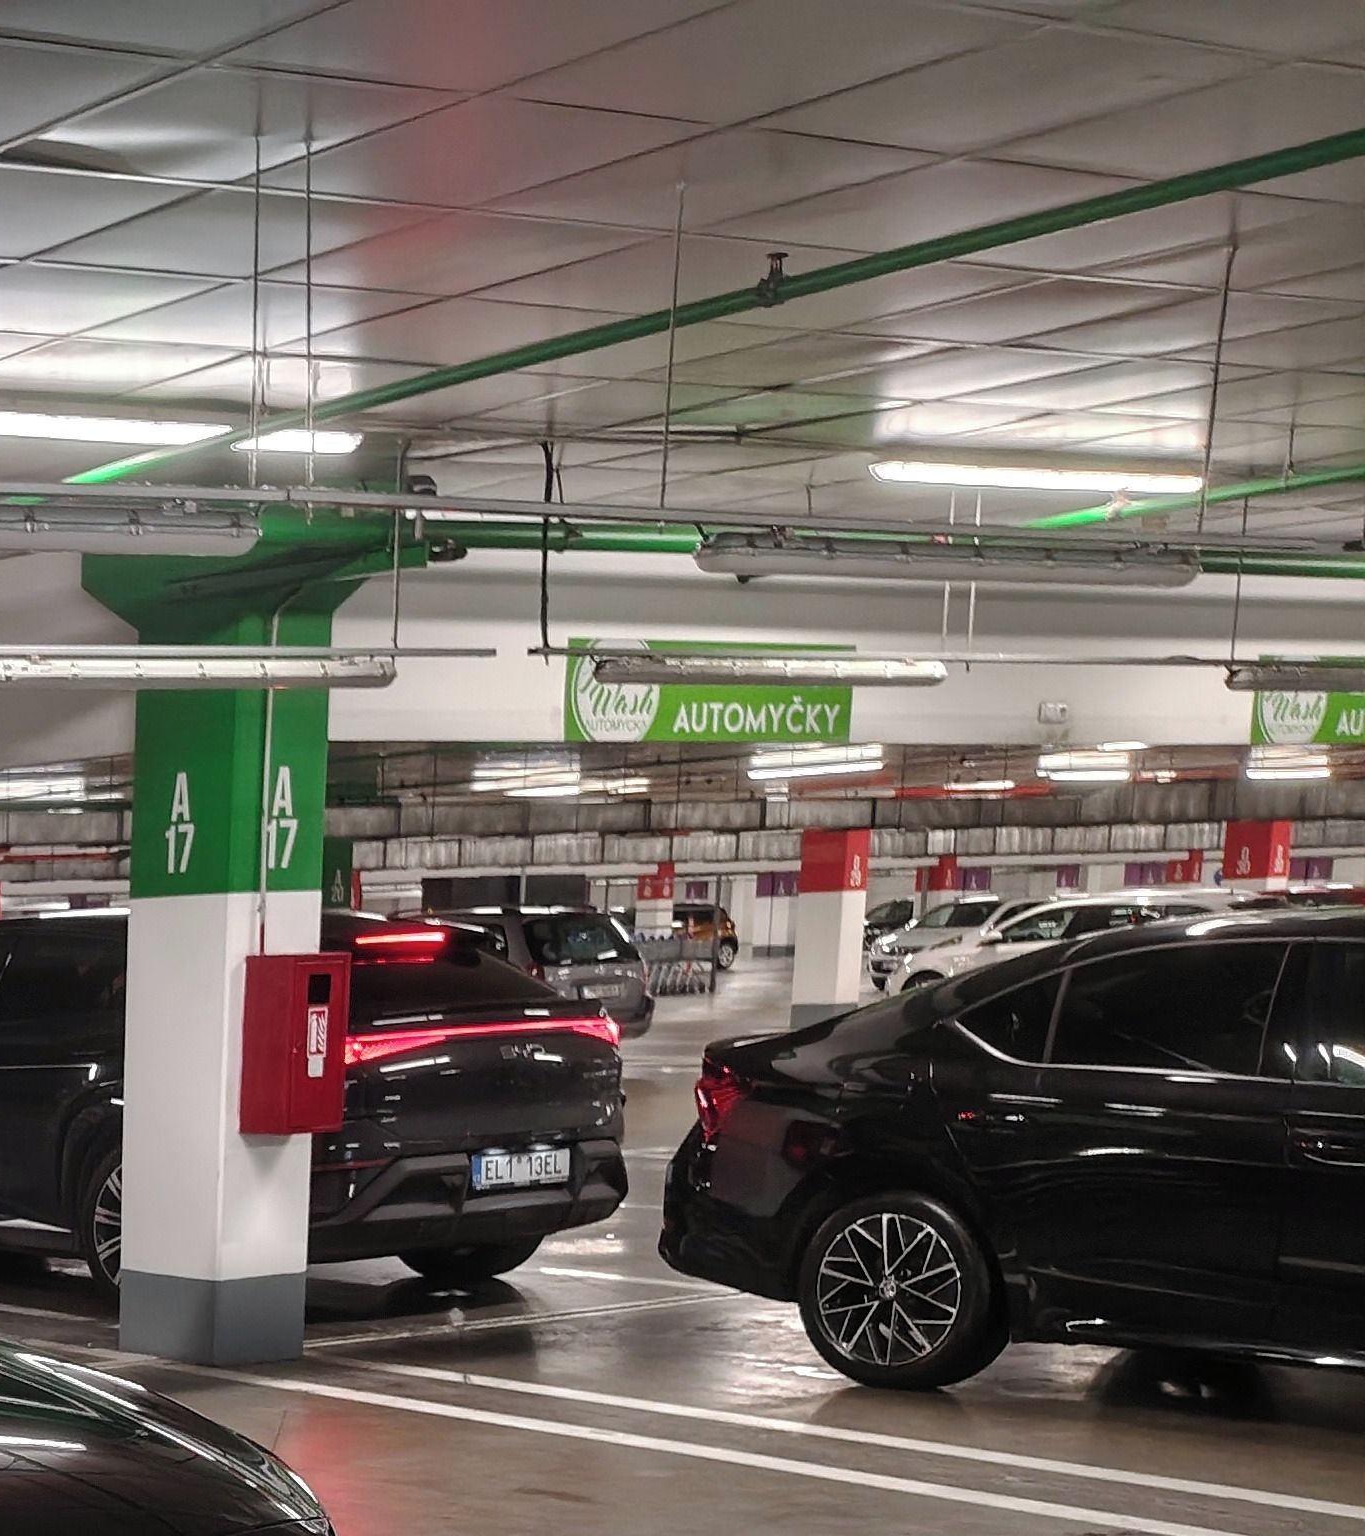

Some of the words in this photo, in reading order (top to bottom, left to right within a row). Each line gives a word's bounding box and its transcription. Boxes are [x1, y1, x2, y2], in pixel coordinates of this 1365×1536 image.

[672, 695, 841, 734] AUTOMYČKY
[171, 771, 191, 822] A
[272, 765, 293, 817] A
[165, 823, 195, 874] 17
[267, 818, 298, 870] 17
[485, 1156, 513, 1180] EL1
[527, 1153, 562, 1177] 13EL
